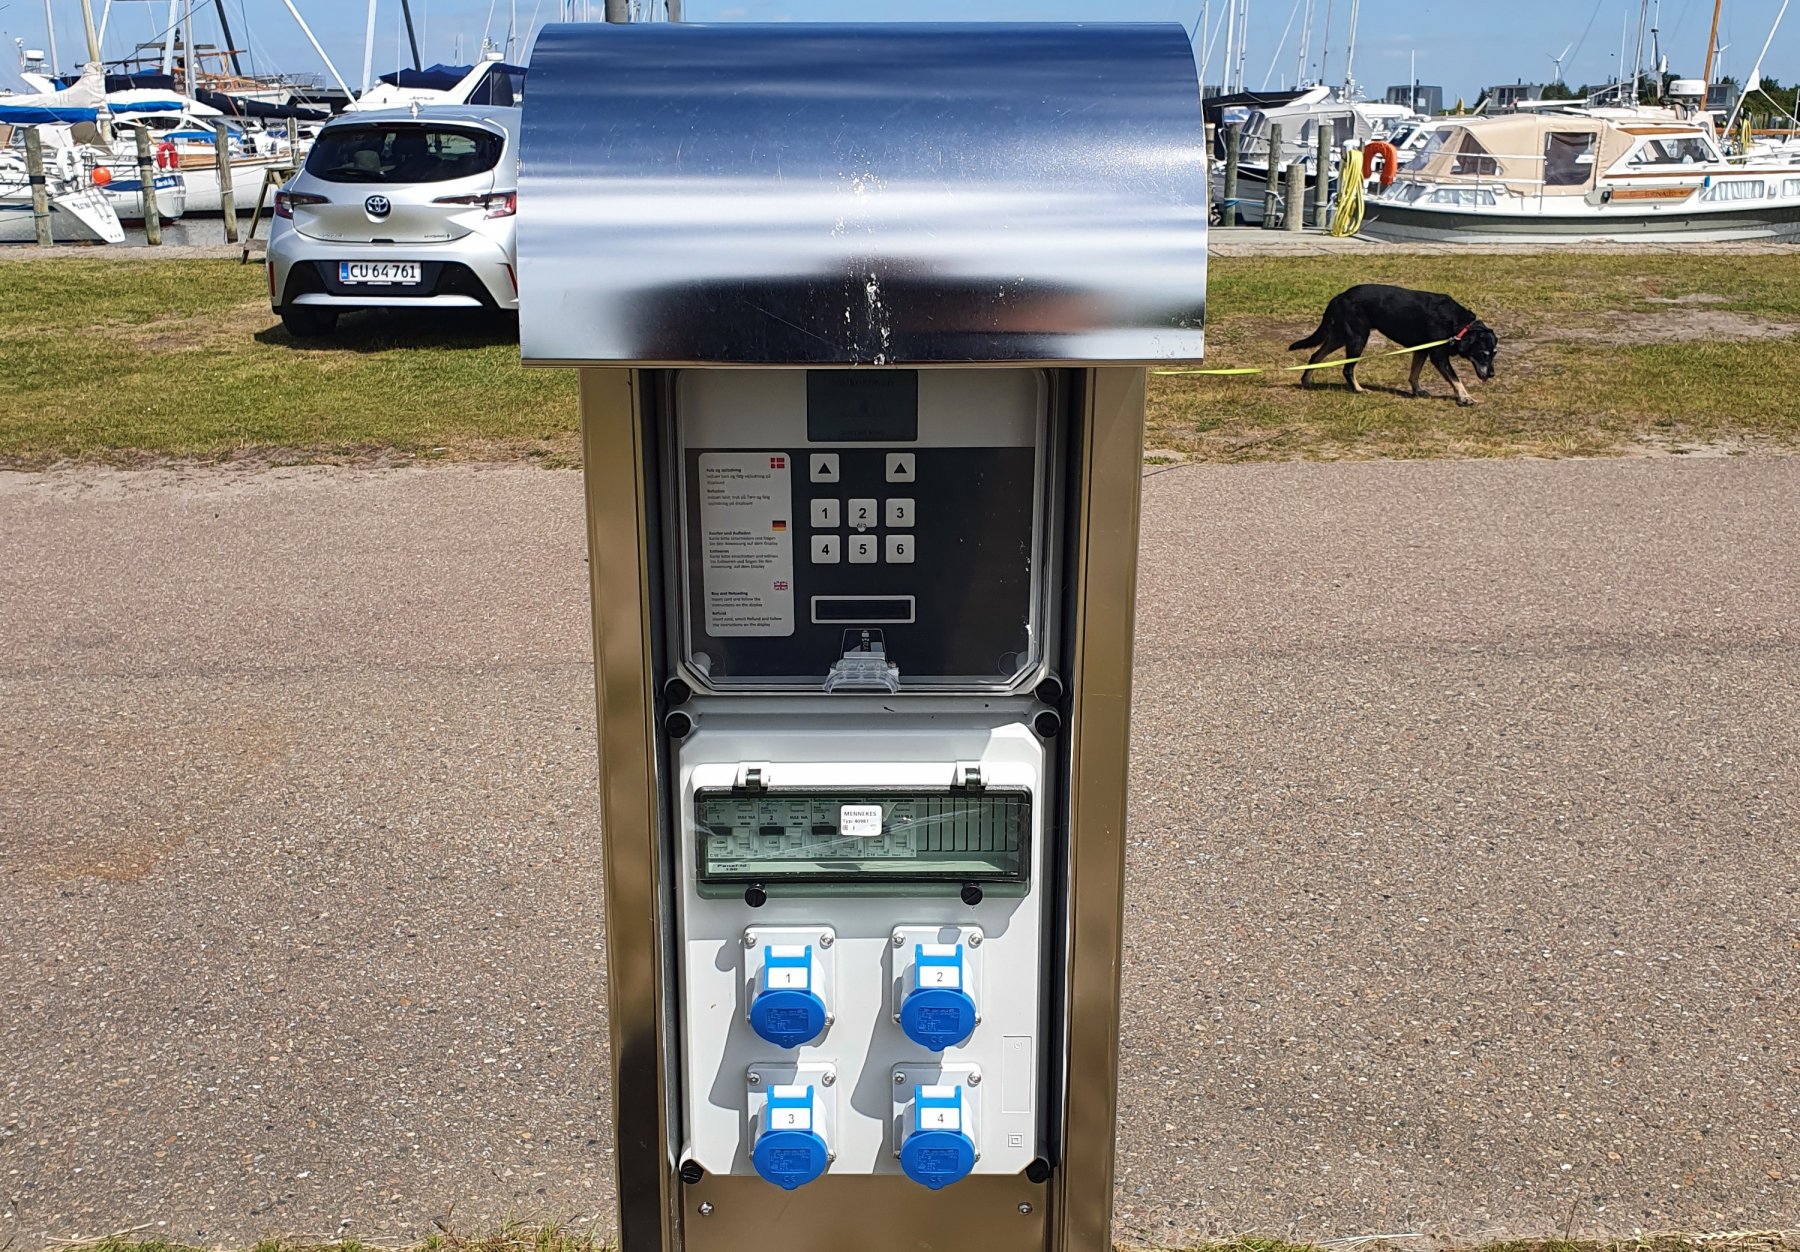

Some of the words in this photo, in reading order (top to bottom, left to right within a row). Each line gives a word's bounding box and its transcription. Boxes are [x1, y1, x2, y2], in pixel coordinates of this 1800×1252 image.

[351, 264, 368, 278] CU
[372, 264, 389, 278] 64
[392, 264, 416, 278] 761
[821, 507, 828, 520] 1
[858, 507, 867, 519] 2
[896, 507, 905, 519] 3
[821, 543, 830, 556] 4
[859, 543, 867, 555] 5
[896, 543, 905, 555] 6
[785, 973, 791, 984] 1
[936, 971, 944, 982] 2
[788, 1113, 795, 1124] 3
[937, 1113, 944, 1123] 4
